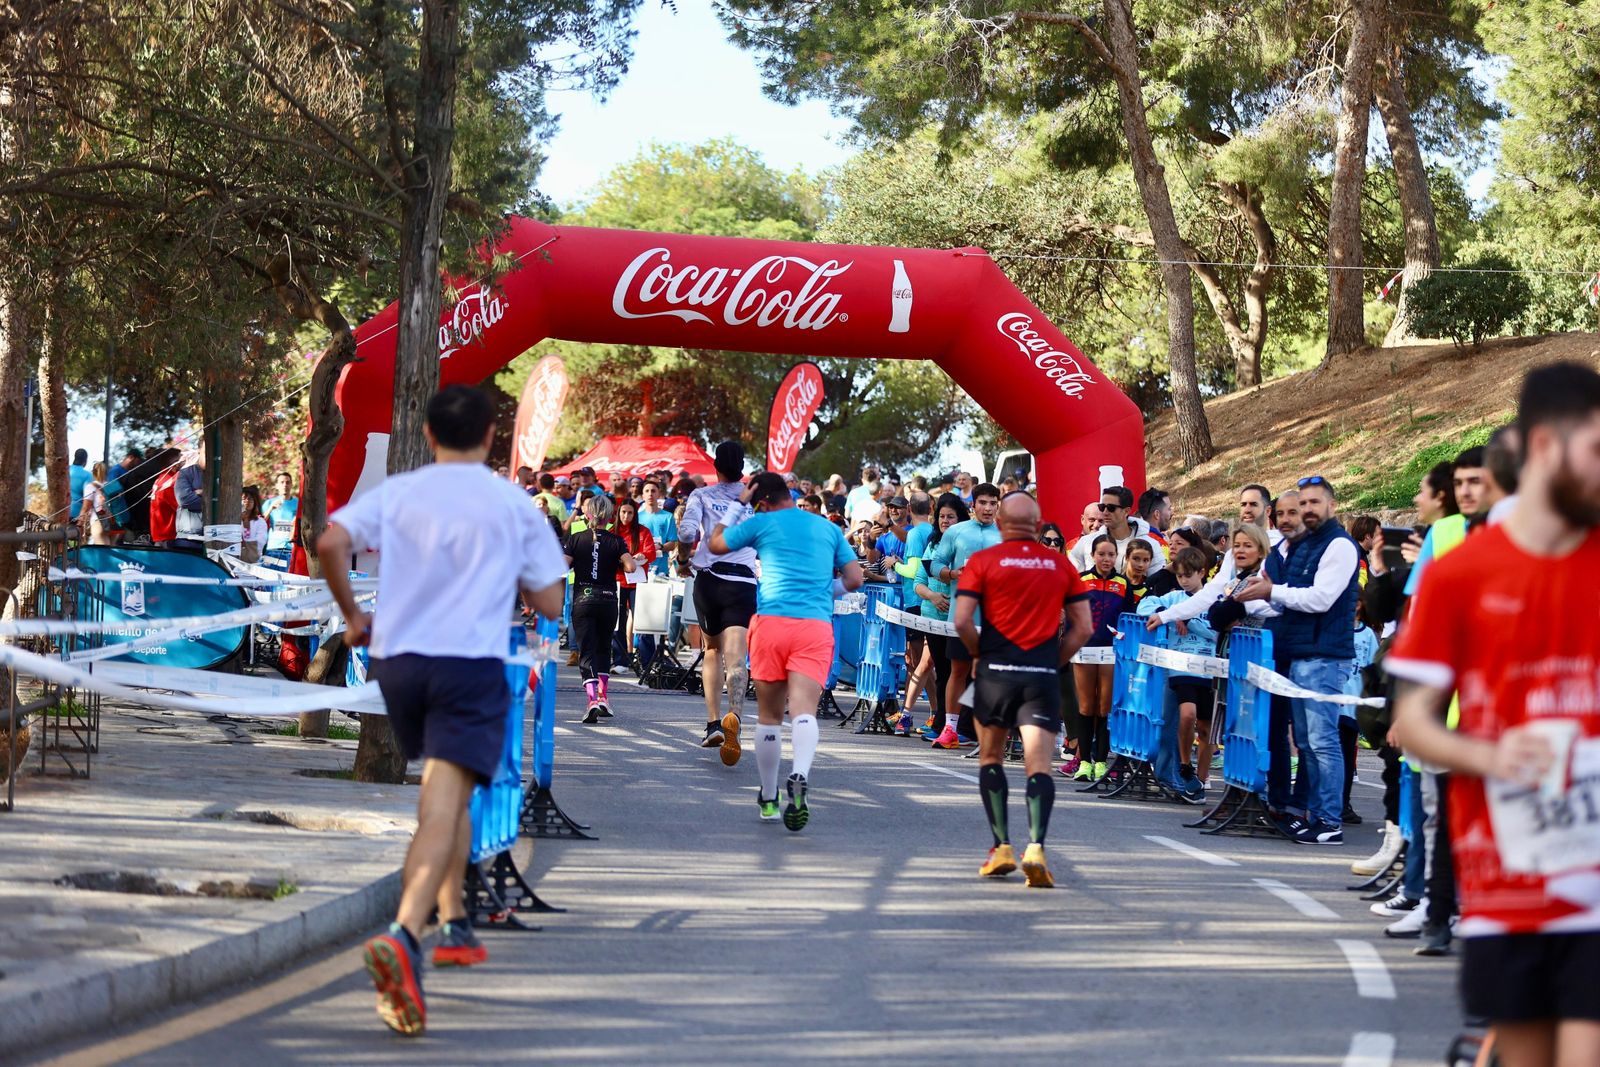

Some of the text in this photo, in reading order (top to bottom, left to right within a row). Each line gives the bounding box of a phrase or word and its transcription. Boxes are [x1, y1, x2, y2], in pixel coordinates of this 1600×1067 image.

[439, 285, 504, 359] a-Cola
[612, 247, 854, 331] Coca-Cola
[997, 312, 1098, 397] Coca-Cola
[769, 367, 817, 470] Coca-Cola
